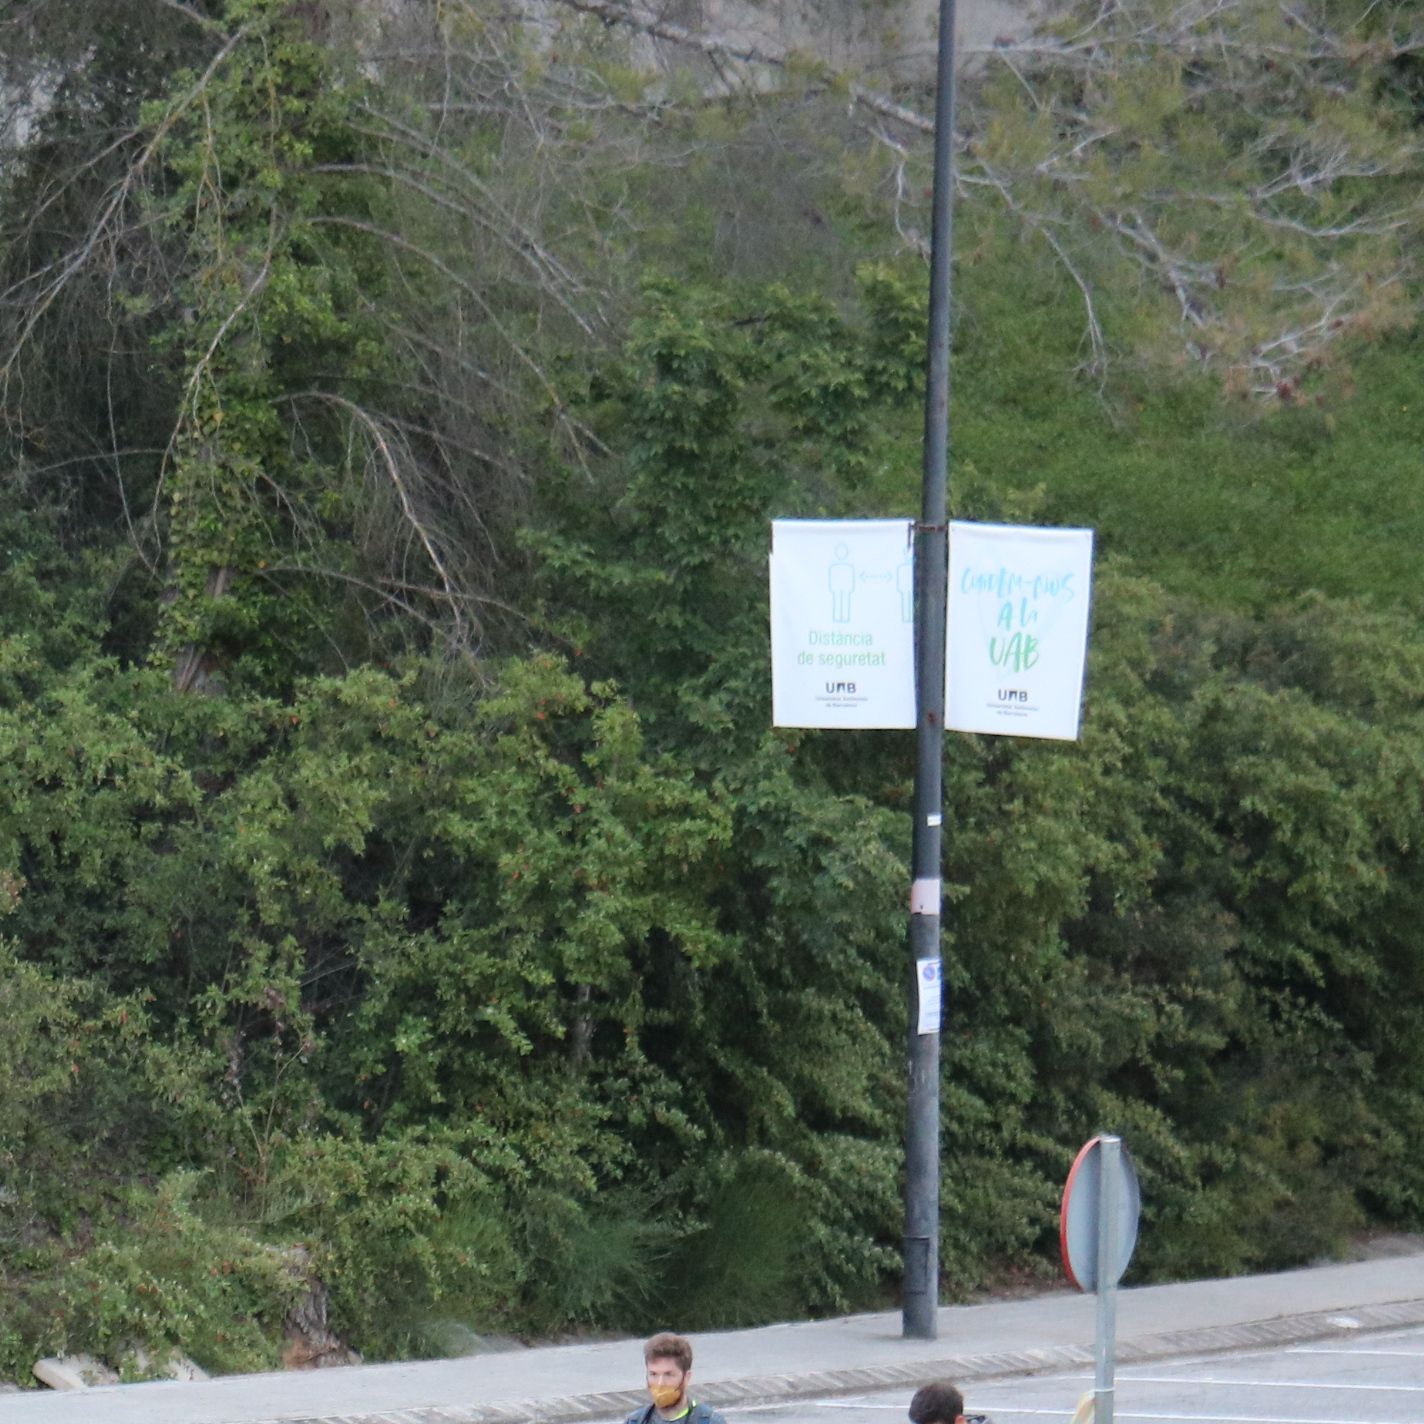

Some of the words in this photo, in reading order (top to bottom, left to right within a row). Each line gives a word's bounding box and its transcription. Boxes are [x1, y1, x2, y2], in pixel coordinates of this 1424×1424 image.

[808, 630, 873, 646] Distància
[798, 650, 814, 666] de
[817, 650, 886, 669] seguretat
[989, 634, 1040, 673] UAB
